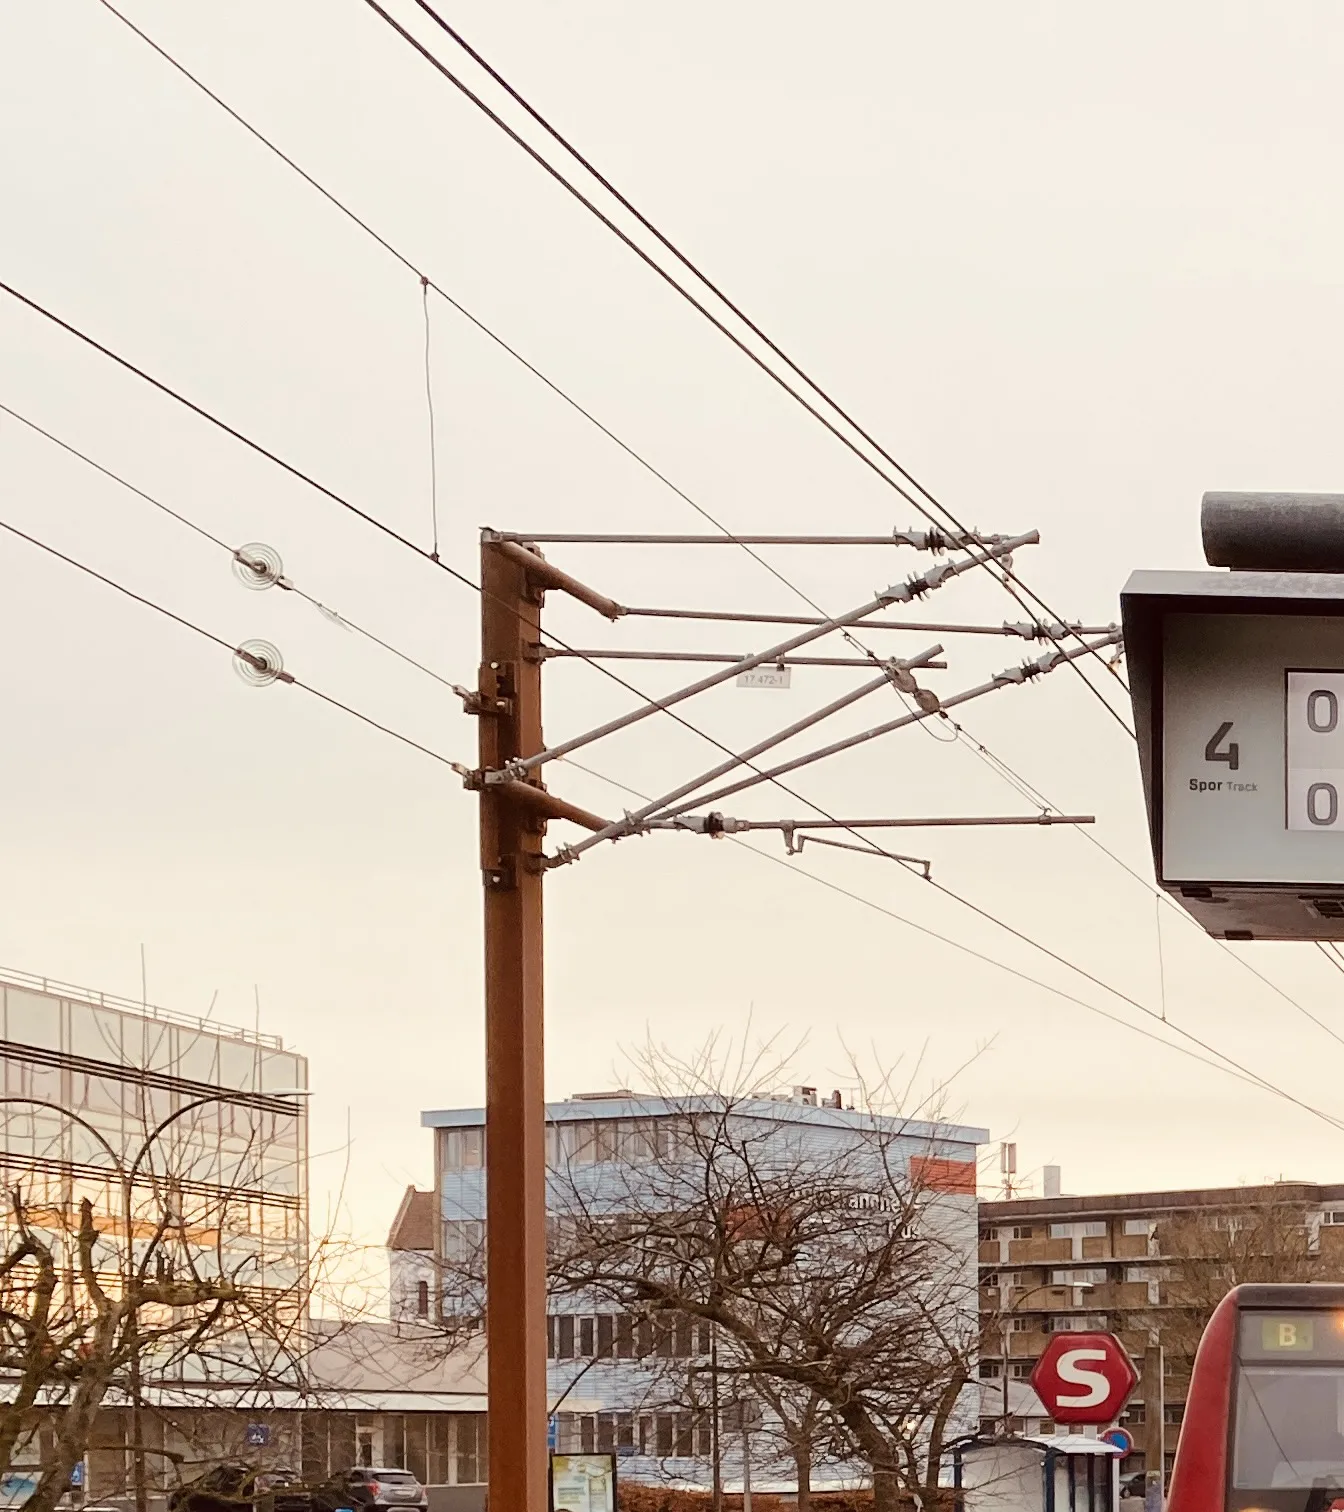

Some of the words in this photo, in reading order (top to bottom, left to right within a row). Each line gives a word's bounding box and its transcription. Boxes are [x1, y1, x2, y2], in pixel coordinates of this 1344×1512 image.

[1204, 721, 1239, 771] 4
[1189, 778, 1223, 793] Spor
[1226, 781, 1259, 792] Track
[1278, 1323, 1297, 1347] B
[1056, 1348, 1111, 1408] S
